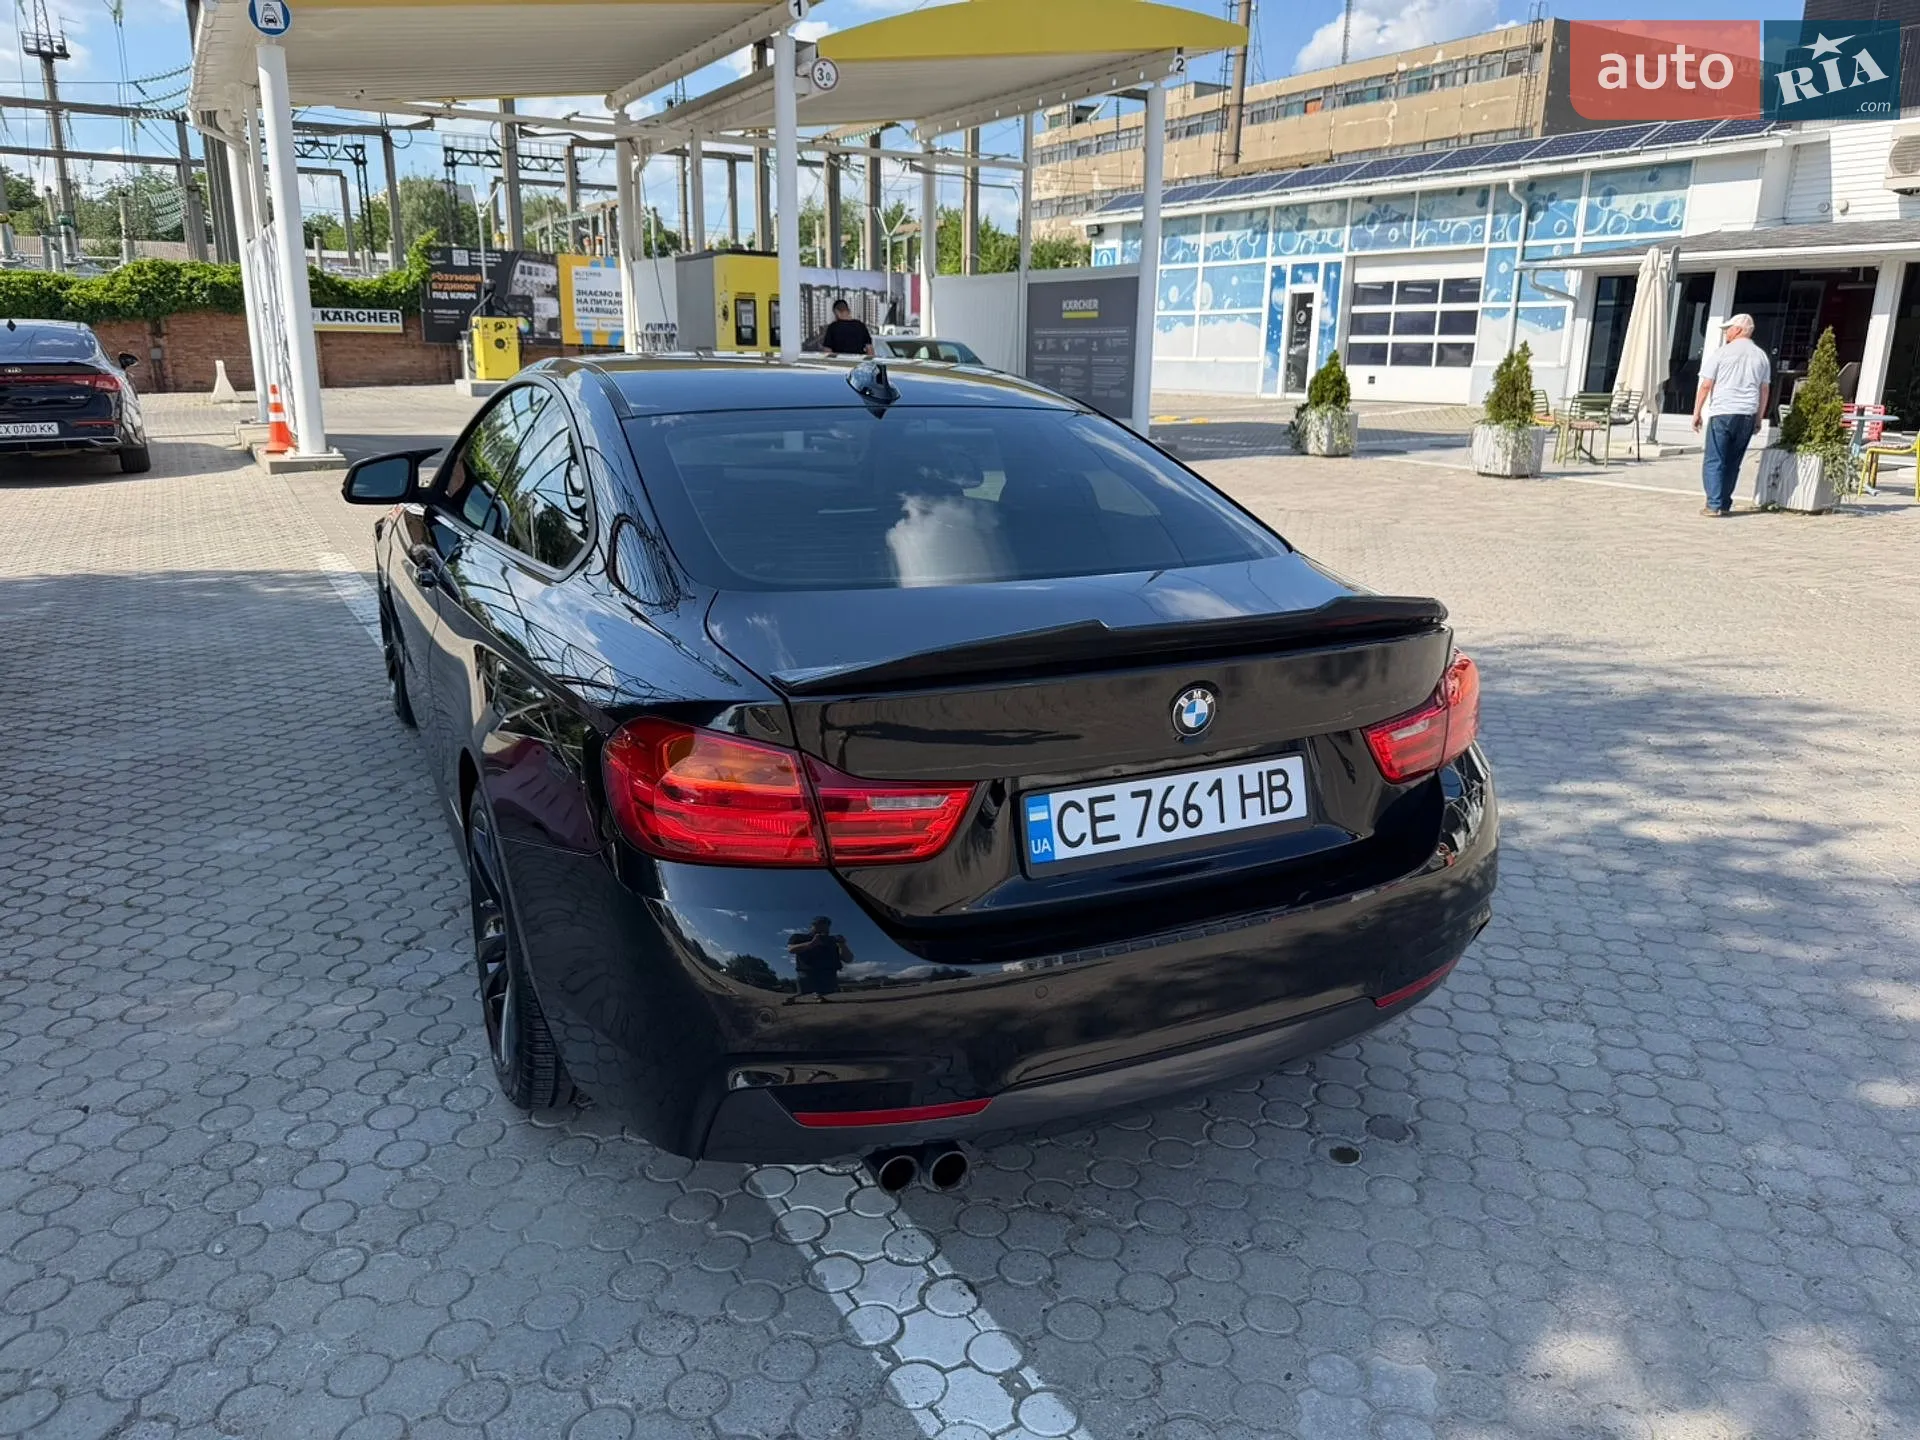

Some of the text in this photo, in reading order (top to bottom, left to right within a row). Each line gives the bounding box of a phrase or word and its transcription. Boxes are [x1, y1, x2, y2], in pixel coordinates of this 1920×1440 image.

[793, 0, 802, 16] 1
[1175, 57, 1184, 72] 2
[13, 424, 37, 434] 0700
[39, 423, 56, 433] KK
[1057, 767, 1293, 848] CE 7661 HB
[1031, 838, 1051, 855] UA
